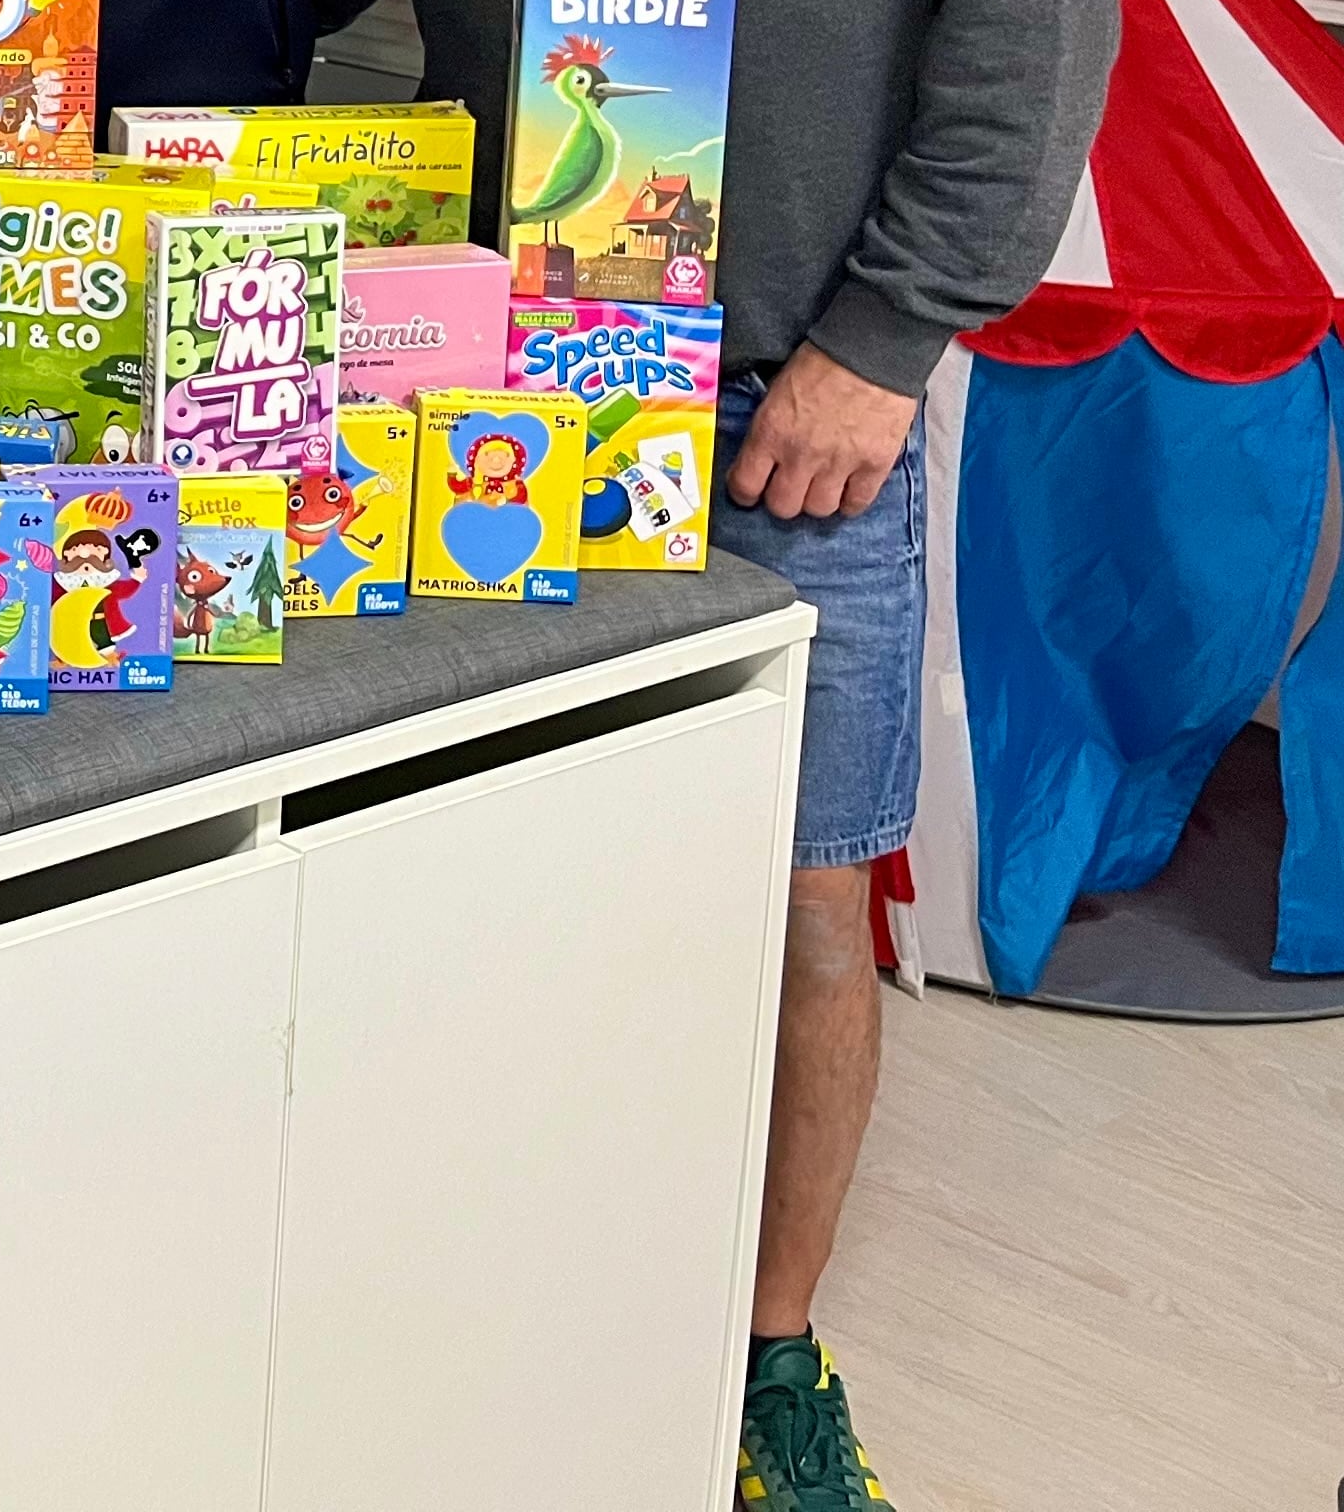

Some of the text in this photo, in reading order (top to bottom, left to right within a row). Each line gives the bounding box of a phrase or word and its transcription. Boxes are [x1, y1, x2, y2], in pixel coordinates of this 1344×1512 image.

[145, 138, 224, 163] HABA
[523, 319, 666, 386] Speed
[570, 357, 695, 403] Cups
[429, 410, 470, 422] simple
[428, 422, 459, 432] rules
[185, 497, 242, 518] Little
[219, 515, 257, 530] Fox
[417, 578, 519, 595] MATRIOSHKA
[78, 670, 115, 684] HAT
